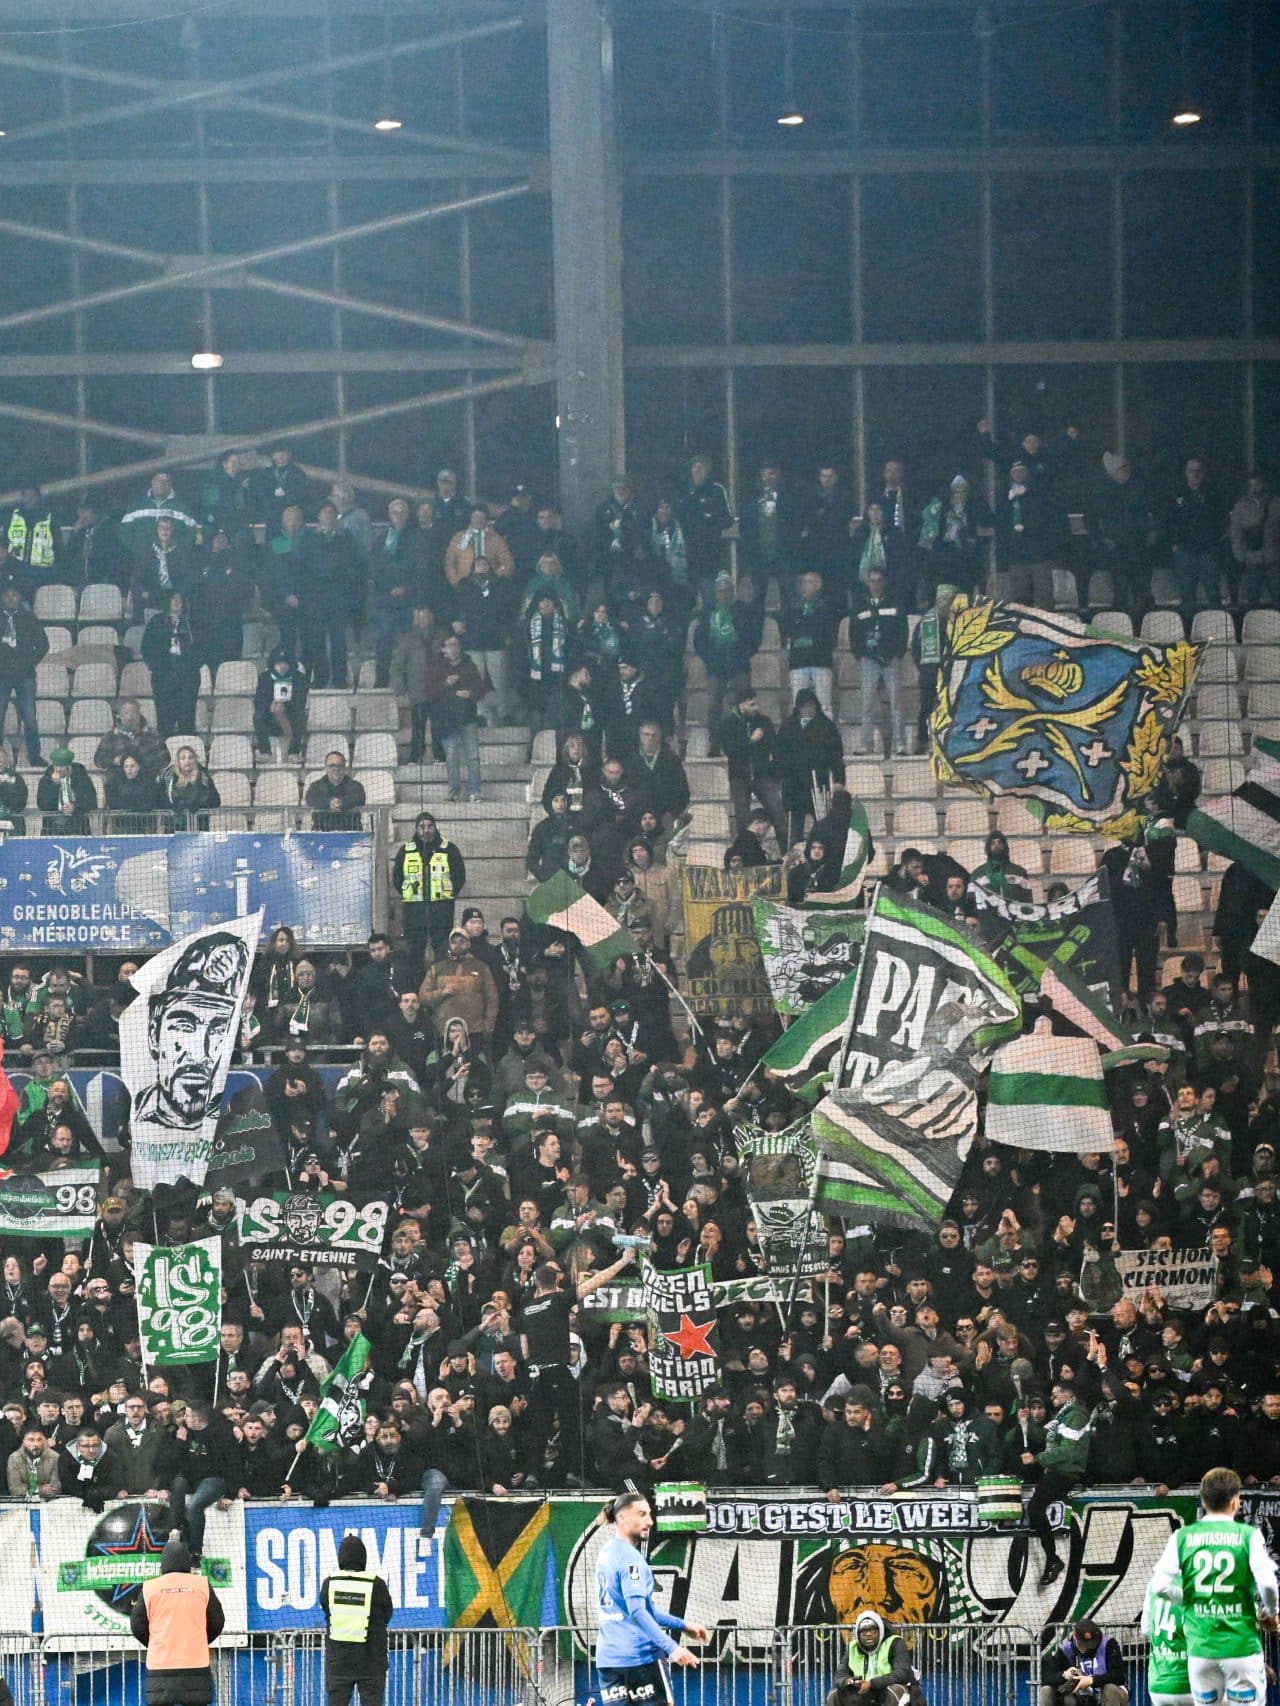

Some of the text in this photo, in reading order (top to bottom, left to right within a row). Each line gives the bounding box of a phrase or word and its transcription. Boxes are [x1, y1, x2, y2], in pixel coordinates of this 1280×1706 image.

[32, 921, 131, 942] MÉTROPOLE
[56, 1186, 96, 1214] 98
[325, 1200, 389, 1246] 98
[252, 1249, 357, 1265] SAINT-ETIENNE
[1137, 1248, 1213, 1266] SECTION
[155, 1254, 209, 1308] IS
[1124, 1268, 1216, 1288] CLERMON
[151, 1306, 217, 1350] 98
[855, 1503, 893, 1530] LE
[1193, 1550, 1236, 1593] 22
[601, 1684, 655, 1701] LCR LCR
